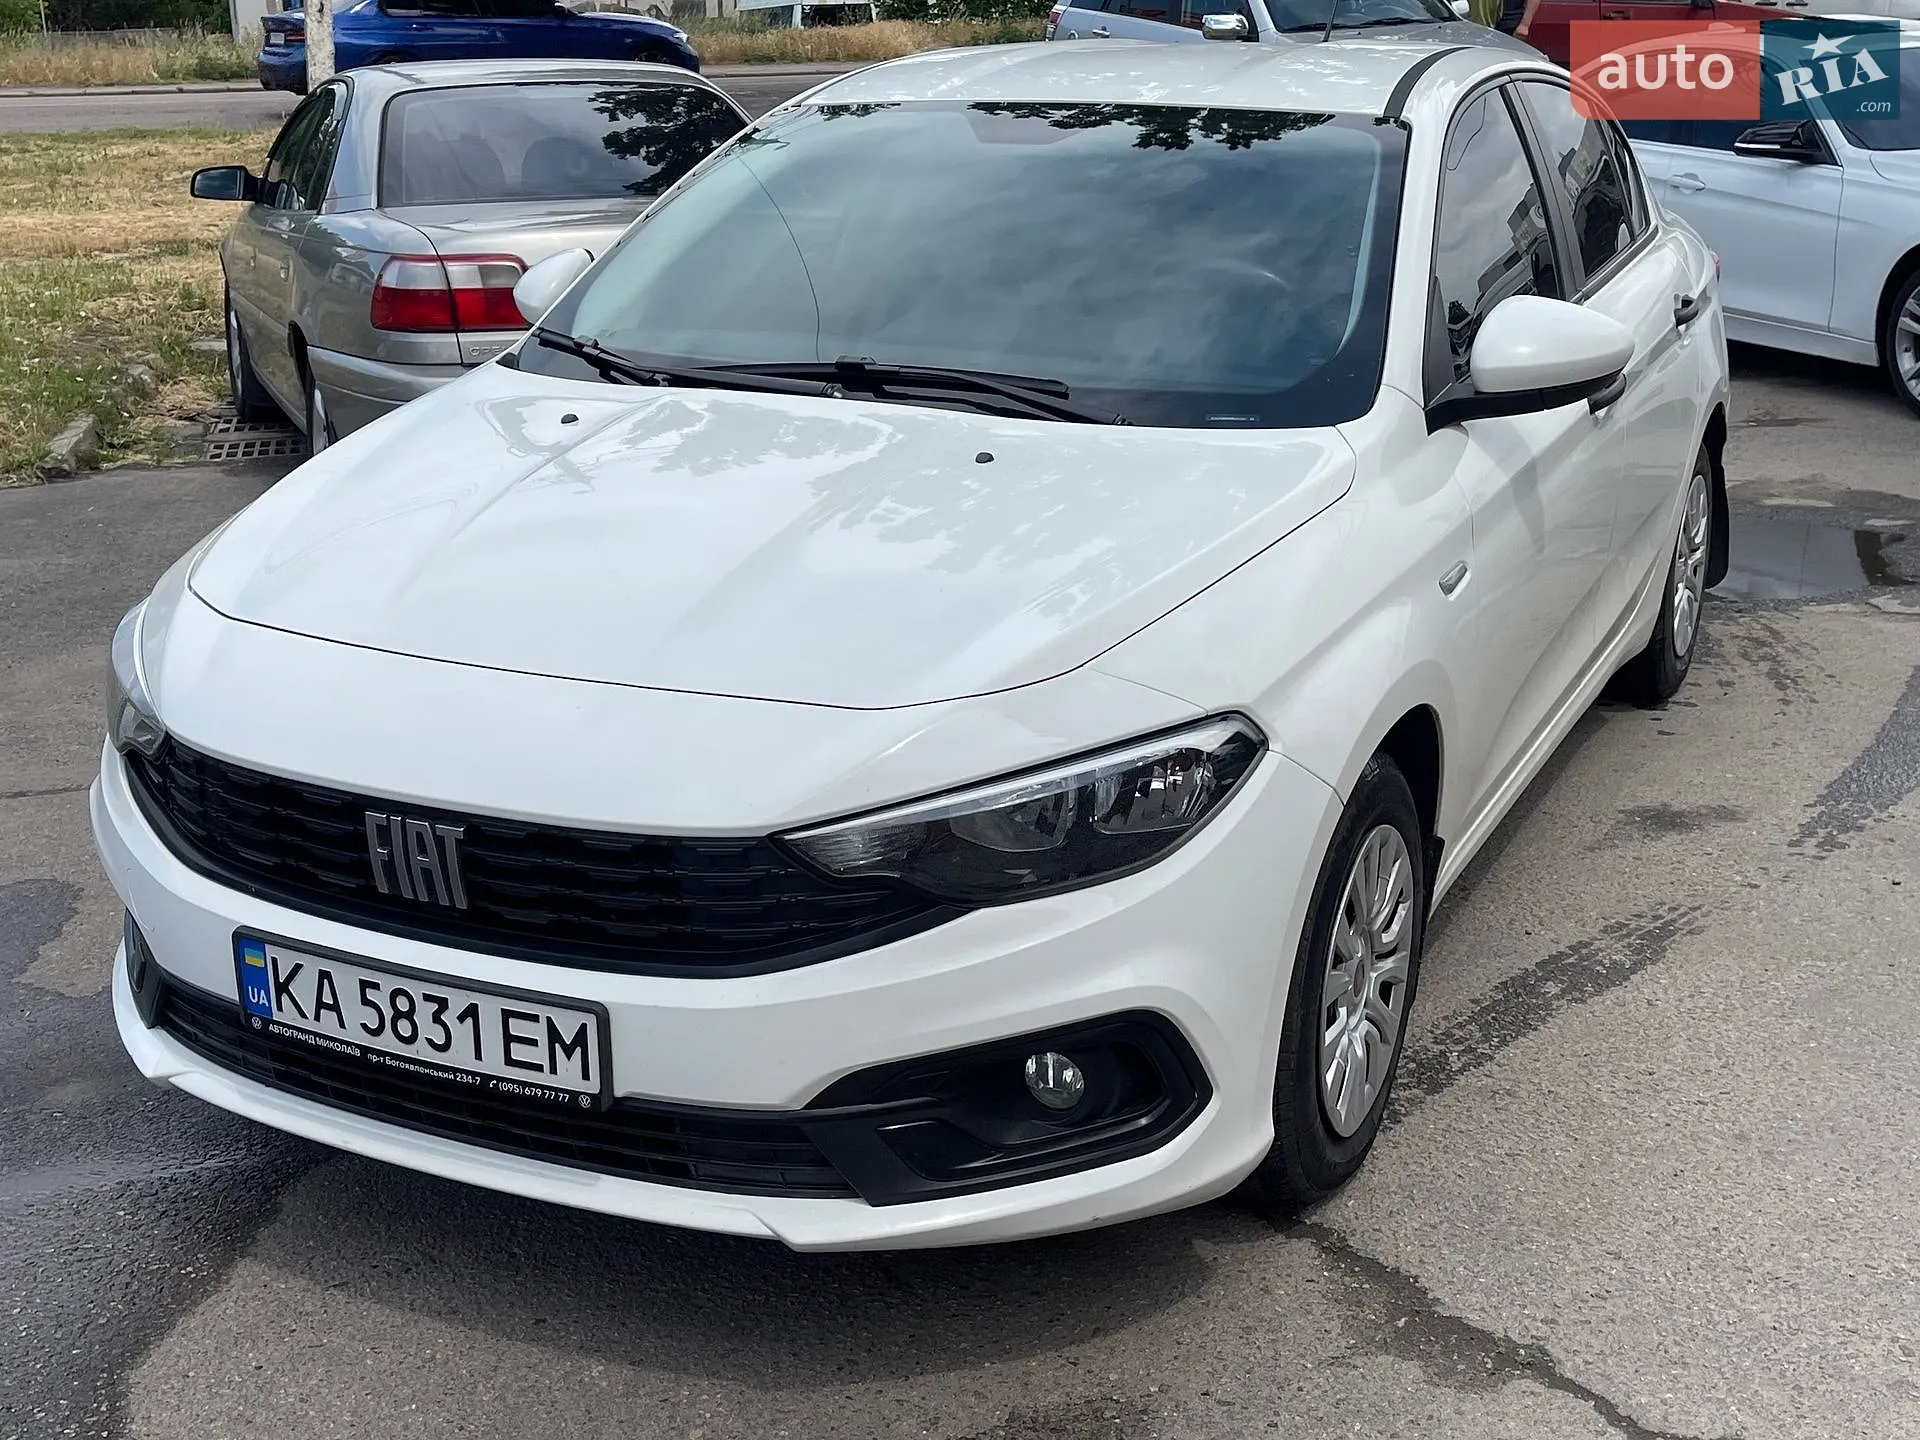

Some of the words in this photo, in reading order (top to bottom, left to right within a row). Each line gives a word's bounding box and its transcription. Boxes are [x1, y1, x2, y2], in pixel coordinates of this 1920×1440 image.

[365, 811, 467, 909] FIAT
[248, 985, 269, 1007] UA
[270, 955, 347, 1030] KA
[358, 977, 483, 1062] 5831
[501, 1007, 591, 1081] EM
[268, 1023, 316, 1045] АВТОГРАНД
[316, 1037, 361, 1056] МИКОЛАЇВ
[456, 1073, 481, 1085] 234-7
[498, 1081, 523, 1095] (095)
[524, 1087, 542, 1097] 679
[543, 1090, 555, 1100] 77
[557, 1092, 569, 1103] 77
